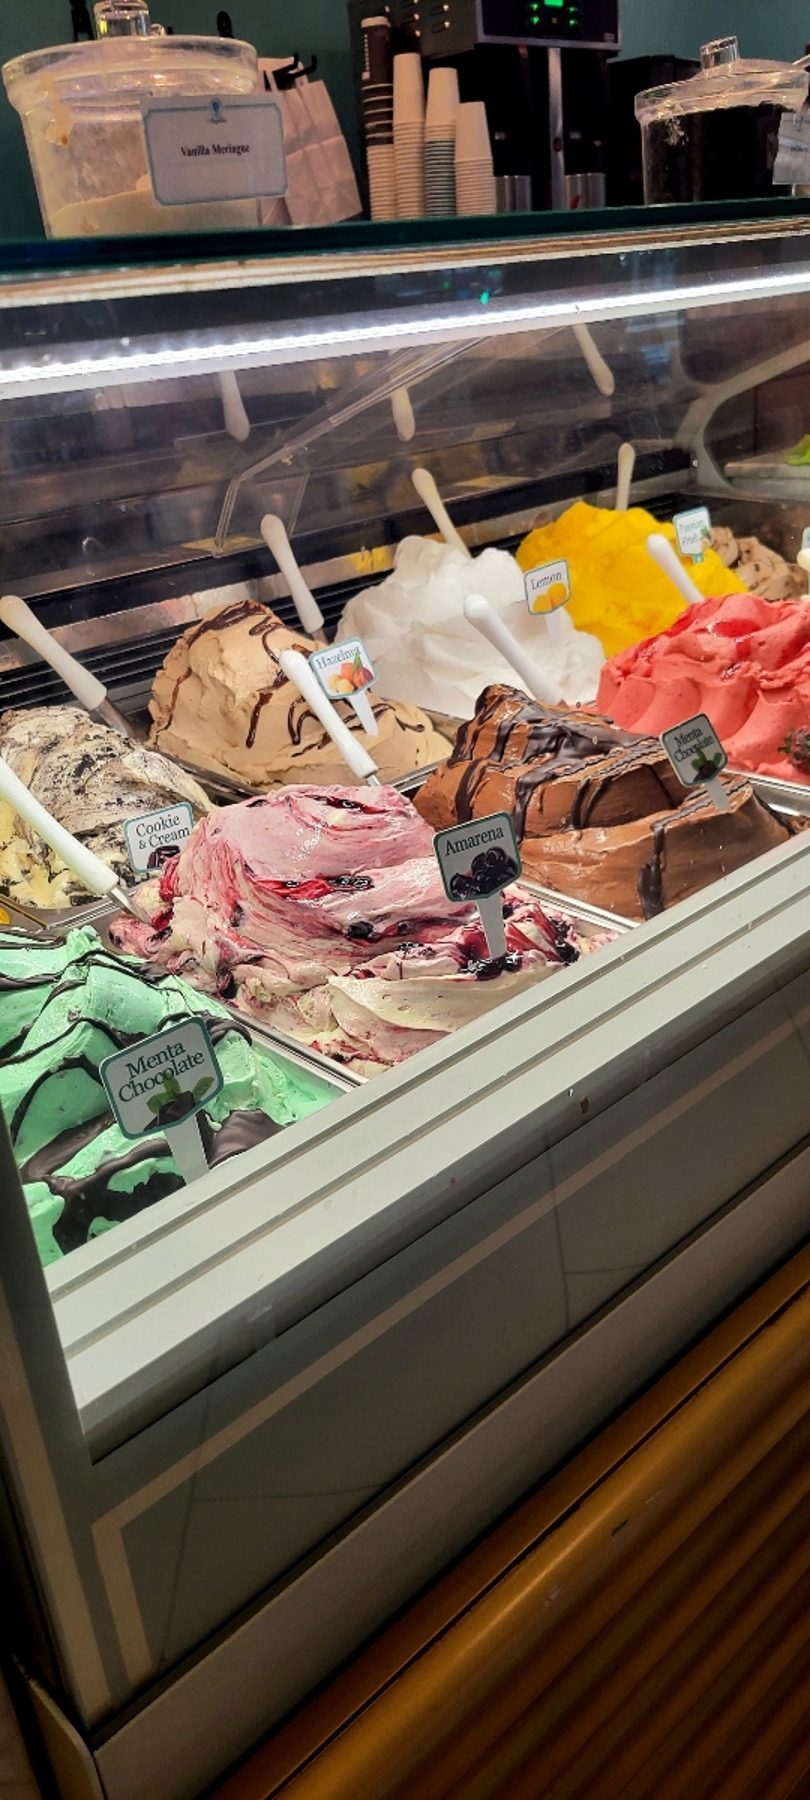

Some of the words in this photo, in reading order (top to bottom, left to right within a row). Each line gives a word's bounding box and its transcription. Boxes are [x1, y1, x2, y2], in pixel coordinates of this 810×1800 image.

[530, 572, 562, 590] Lemon
[315, 646, 362, 669] Hazelnut
[673, 728, 703, 748] Menta
[135, 814, 180, 837] Cookie
[138, 840, 147, 849] &
[148, 827, 190, 848] Cream
[444, 826, 504, 856] Amarena
[124, 1041, 186, 1079] Menta
[118, 1052, 205, 1102] Chocolate
